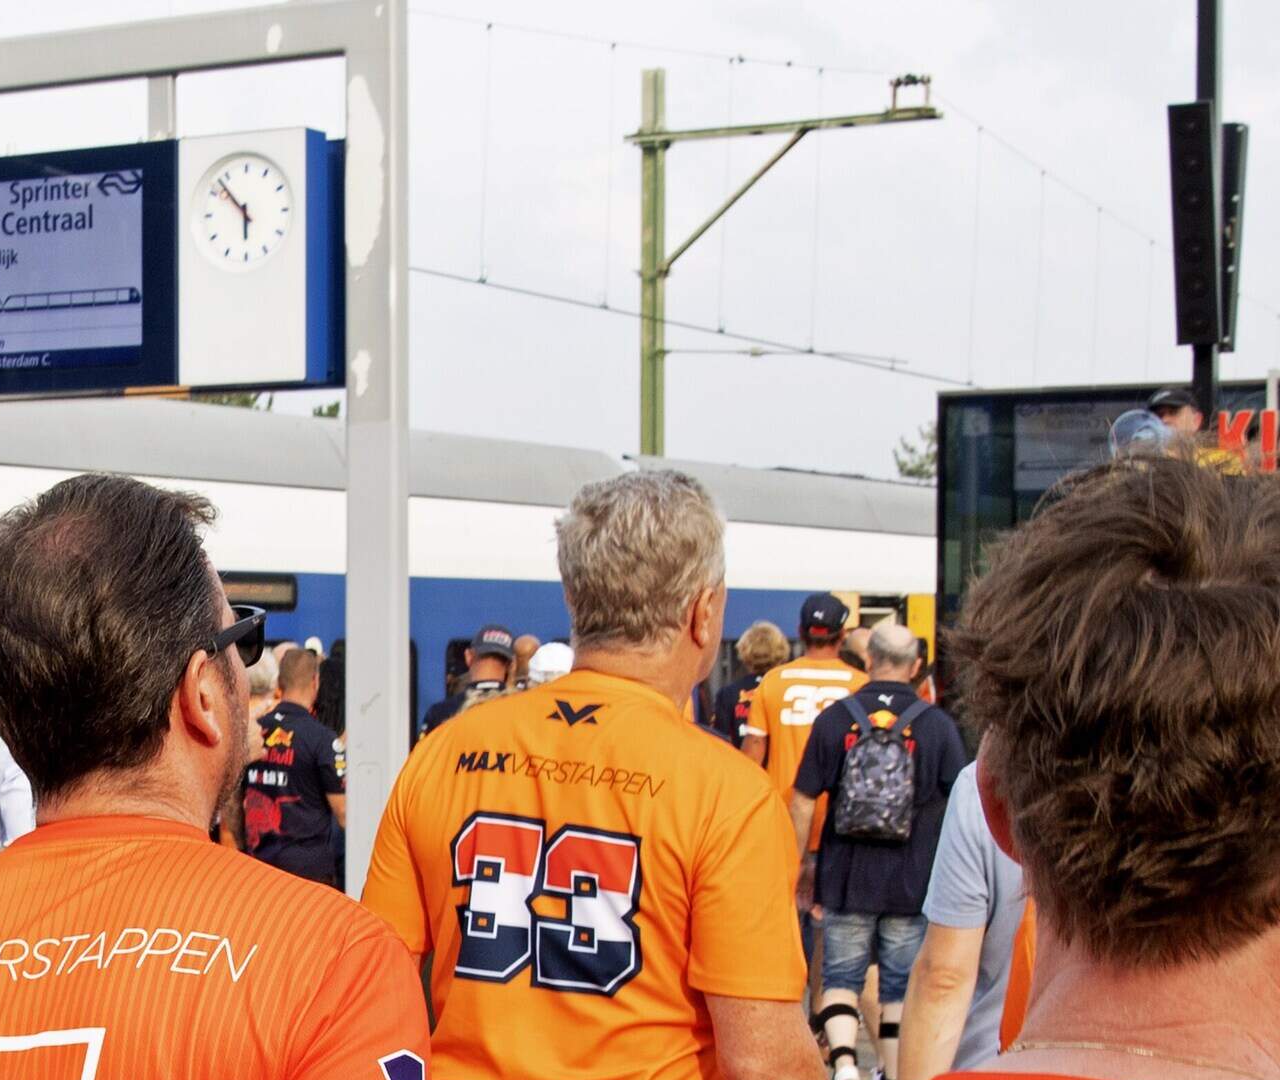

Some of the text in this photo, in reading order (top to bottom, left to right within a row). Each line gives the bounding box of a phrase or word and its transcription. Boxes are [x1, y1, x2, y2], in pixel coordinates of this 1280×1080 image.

[9, 177, 91, 209] Sprinter
[2, 204, 94, 236] Centraal
[450, 811, 643, 997] 33
